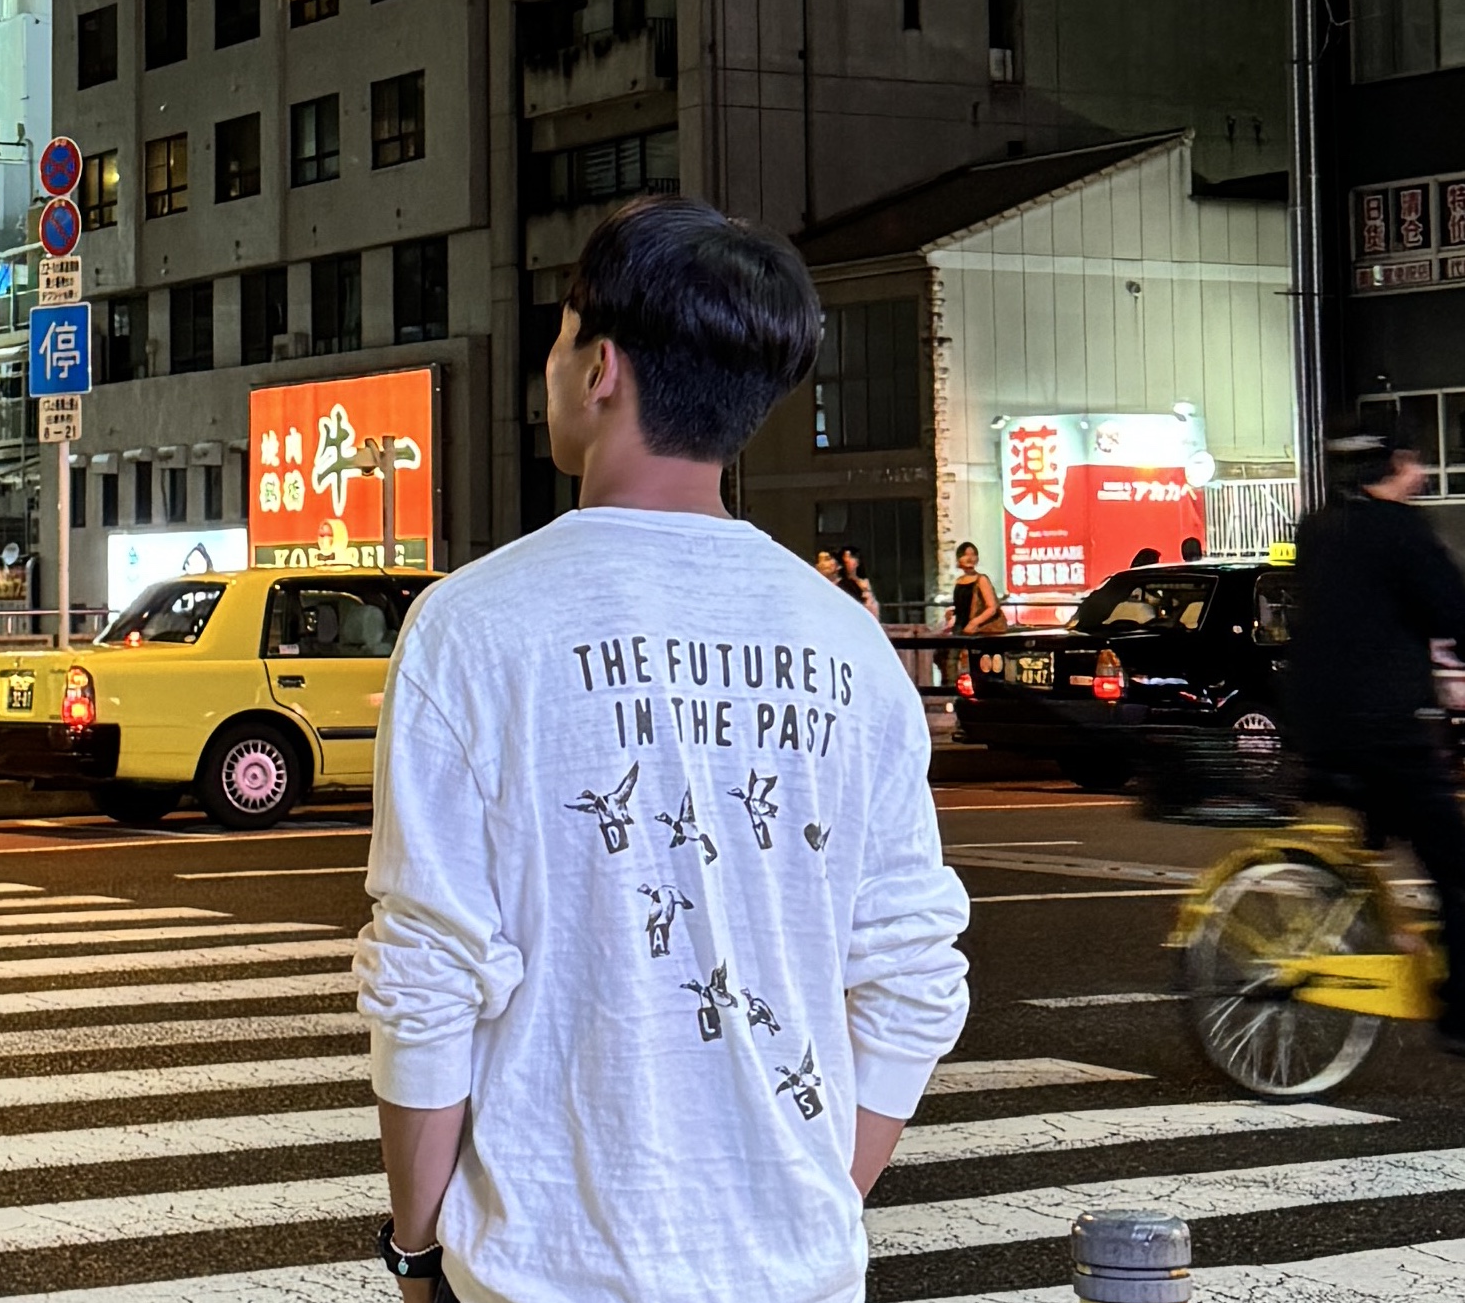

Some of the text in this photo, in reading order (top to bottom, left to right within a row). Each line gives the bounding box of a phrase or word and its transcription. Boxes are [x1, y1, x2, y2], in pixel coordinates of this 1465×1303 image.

[39, 320, 80, 380] 停
[1009, 424, 1060, 506] 薬
[573, 636, 852, 706] THE FUTURE IS
[615, 697, 837, 757] IN THE PAST
